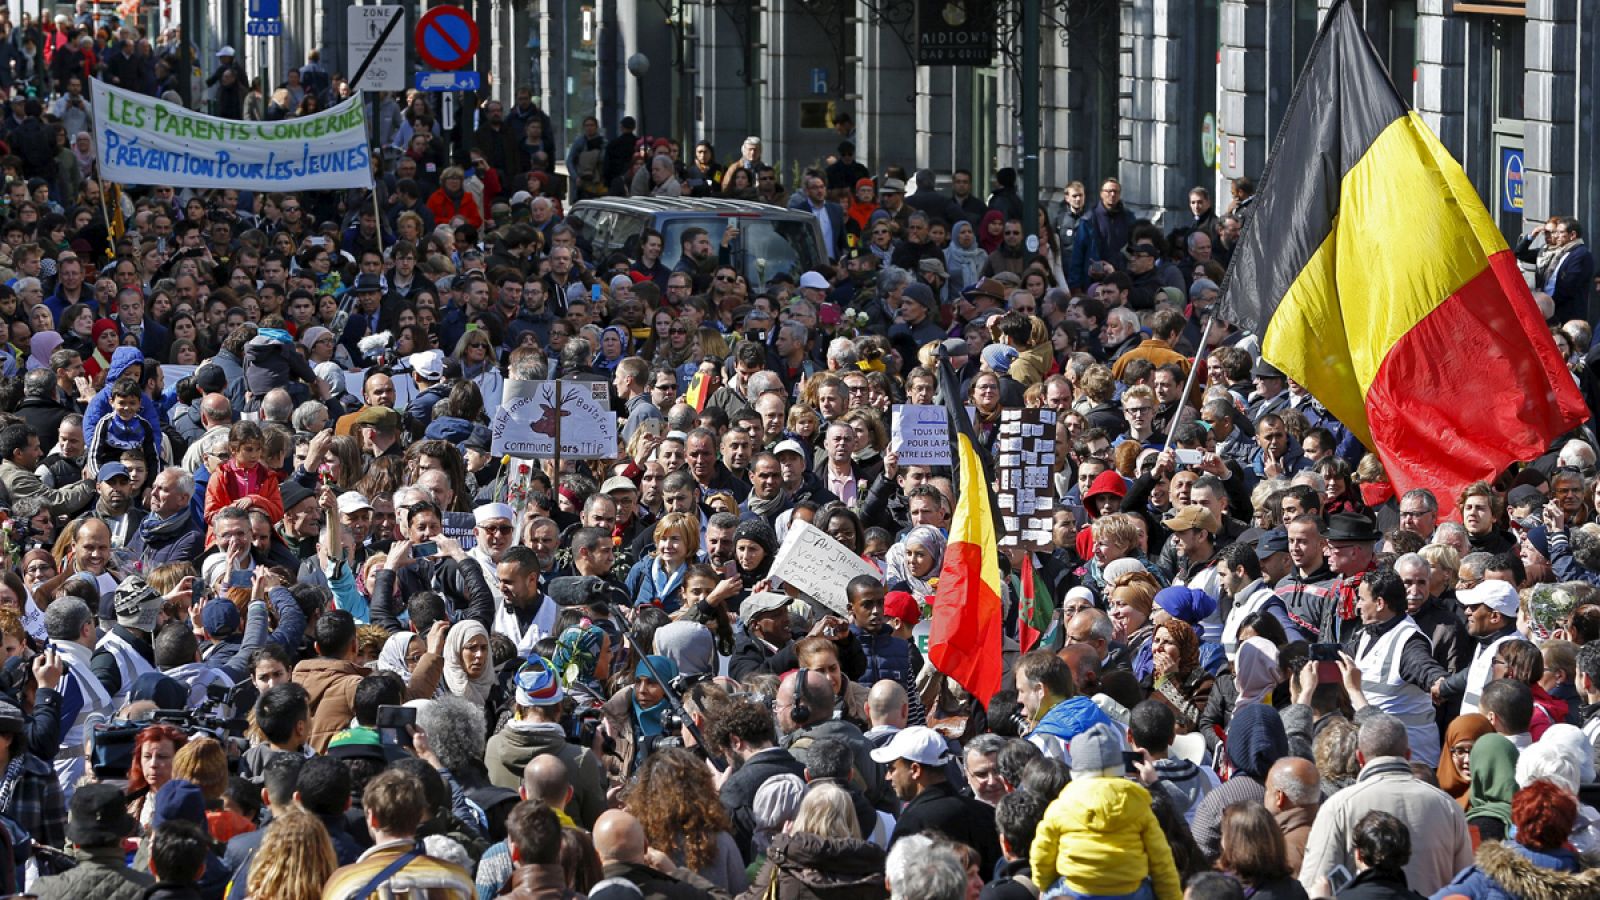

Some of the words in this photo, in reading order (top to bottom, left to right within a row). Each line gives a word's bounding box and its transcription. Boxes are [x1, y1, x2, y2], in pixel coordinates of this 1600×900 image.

[363, 8, 390, 17] ZONE
[250, 23, 278, 33] TAXI
[108, 91, 146, 129] LES
[155, 103, 250, 141] PARENTS
[265, 151, 294, 180] LES
[294, 142, 368, 177] JEUNES
[912, 428, 933, 436] TOUS
[907, 439, 929, 447] POUR
[930, 439, 940, 447] LA
